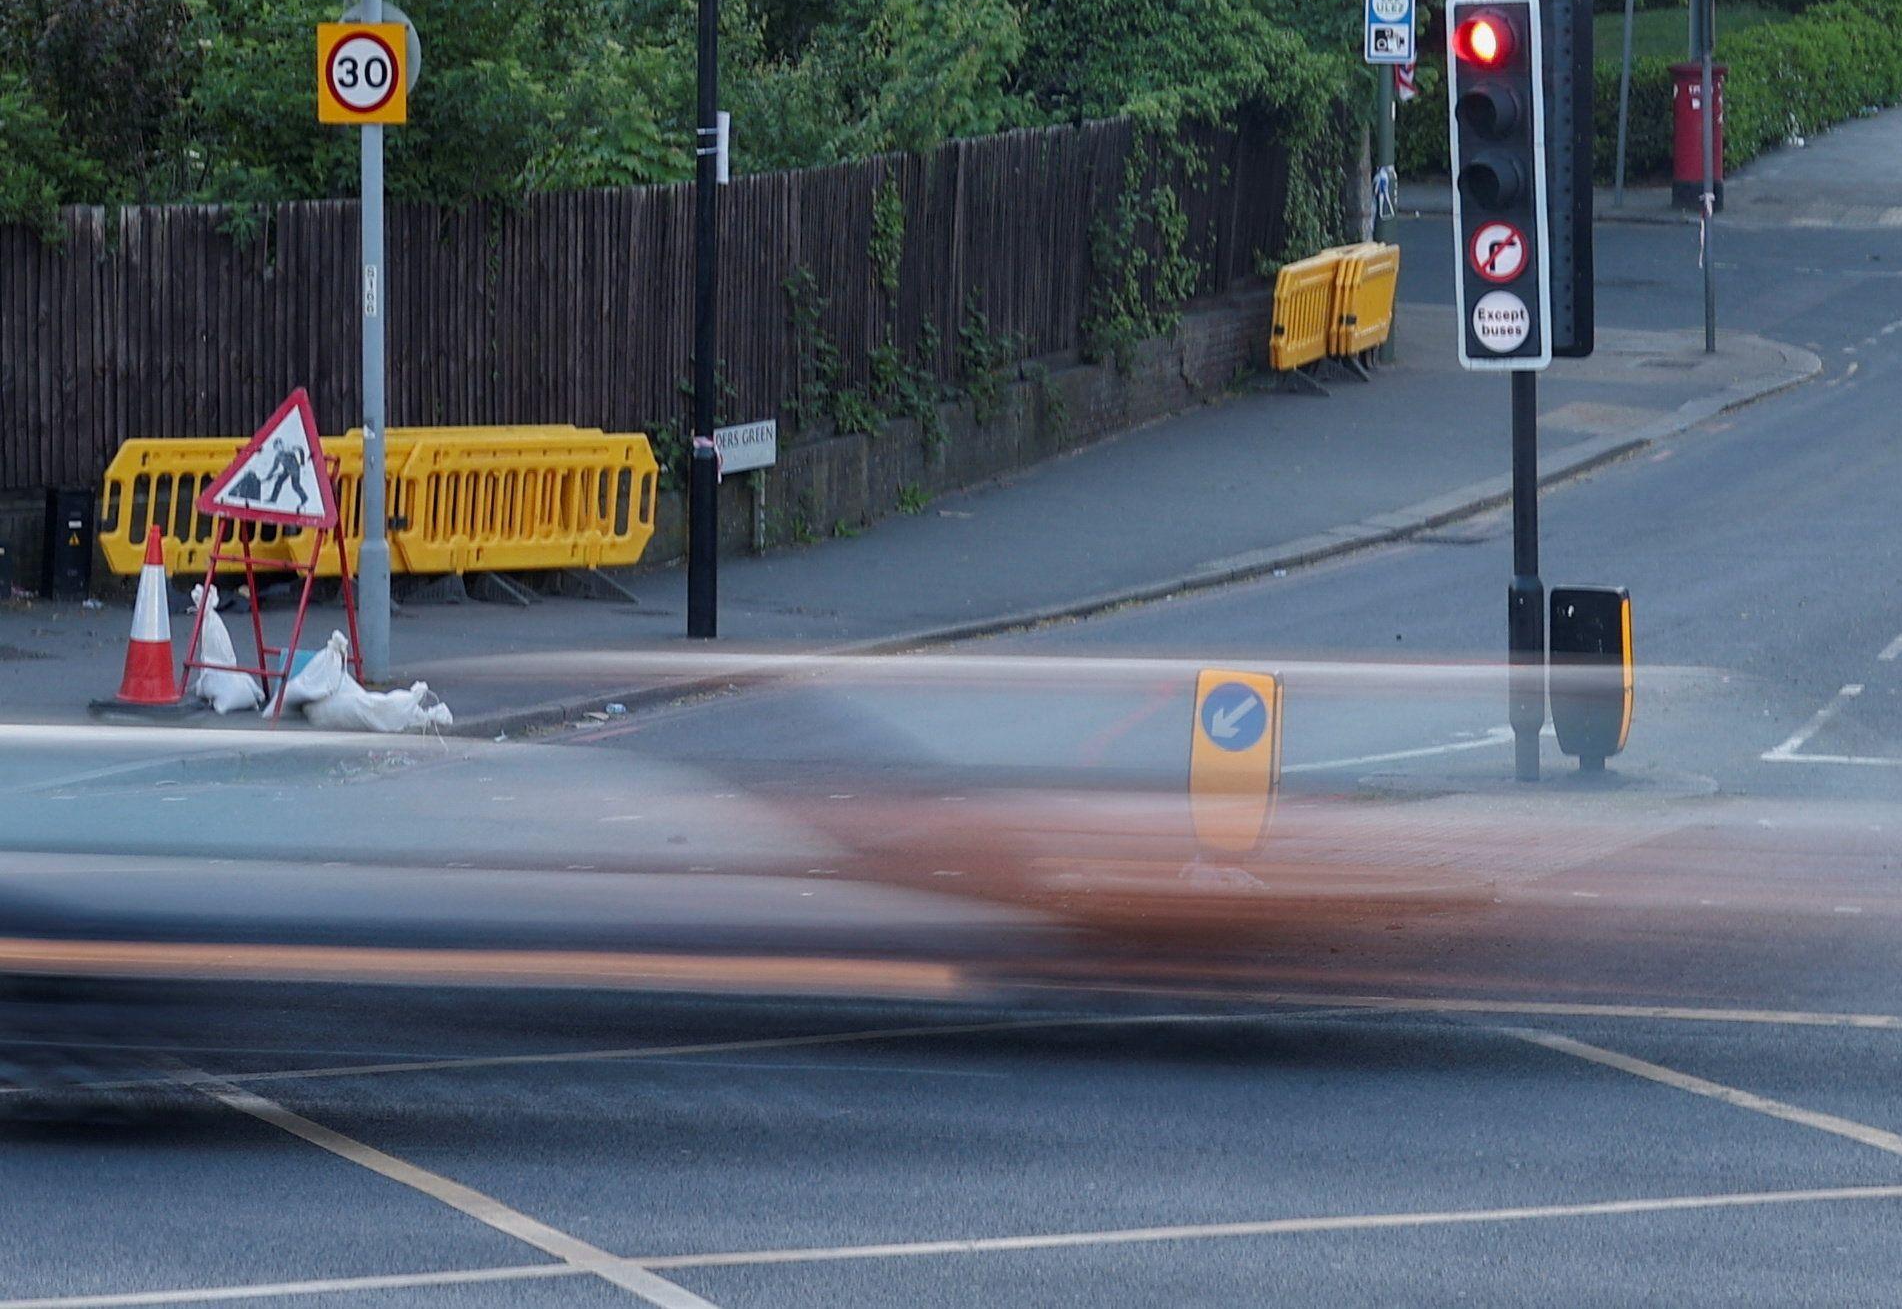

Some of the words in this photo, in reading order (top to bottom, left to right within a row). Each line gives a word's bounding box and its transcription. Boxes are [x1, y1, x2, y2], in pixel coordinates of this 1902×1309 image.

[1376, 3, 1404, 13] ULEZ
[338, 57, 388, 88] 30
[1478, 307, 1525, 323] Except
[1482, 324, 1522, 336] buses
[741, 425, 774, 445] GREEN
